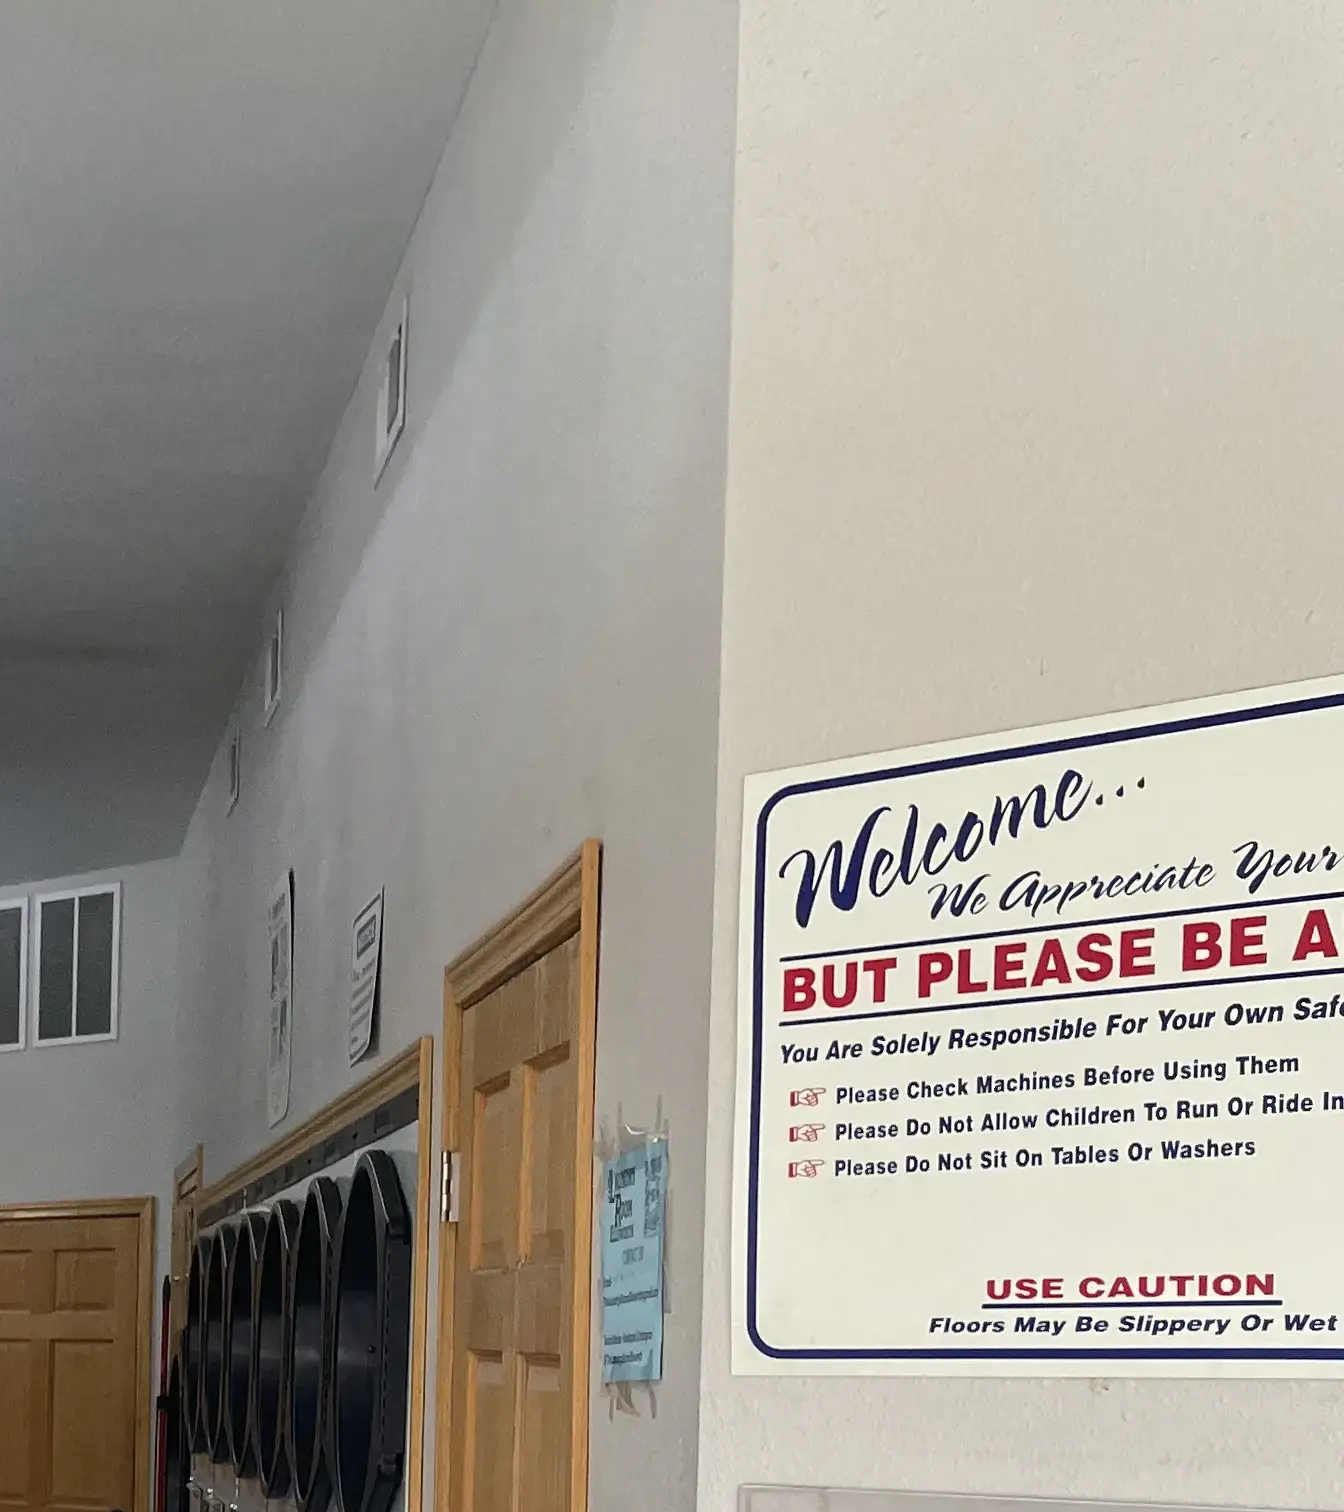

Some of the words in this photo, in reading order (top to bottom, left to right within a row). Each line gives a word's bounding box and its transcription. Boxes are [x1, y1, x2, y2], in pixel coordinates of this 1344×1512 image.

[778, 769, 1145, 929] Welcome...
[927, 873, 991, 920] We
[999, 856, 1216, 918] Appreciate
[1232, 841, 1344, 894] Your
[783, 957, 897, 1012] BUT
[917, 928, 1155, 998] PLEASE
[1182, 915, 1267, 972] BE
[1292, 909, 1339, 962] A
[781, 1044, 819, 1064] You
[825, 1040, 863, 1060] Are
[870, 1031, 941, 1056] Solely
[948, 1017, 1097, 1050] Responsible
[1106, 1014, 1148, 1036] For
[1158, 1009, 1216, 1031] Your
[1224, 1003, 1284, 1026] Own
[836, 1086, 899, 1104] Please
[907, 1078, 968, 1099] Check
[976, 1071, 1075, 1094] Machines
[1084, 1065, 1155, 1087] Before
[1164, 1059, 1227, 1081] Using
[1236, 1055, 1299, 1076] Them
[835, 1123, 899, 1141] Please
[906, 1118, 931, 1136] Do
[939, 1115, 973, 1134] Not
[981, 1112, 1038, 1132] Allow
[1046, 1106, 1135, 1127] Children
[1144, 1102, 1167, 1121] To
[1177, 1100, 1218, 1119] Run
[1228, 1096, 1253, 1116] Or
[1262, 1094, 1313, 1114] Ride
[1324, 1091, 1344, 1110] In
[835, 1158, 897, 1177] Please
[905, 1155, 930, 1173] Do
[938, 1153, 972, 1171] Not
[980, 1150, 1007, 1169] Sit
[1015, 1149, 1043, 1167] On
[1051, 1146, 1119, 1166] Tables
[1128, 1143, 1152, 1161] Or
[1161, 1138, 1256, 1160] Washers
[986, 1278, 1064, 1300] USE
[1078, 1273, 1275, 1298] CAUTION
[929, 1317, 1005, 1334] Floors
[1014, 1316, 1066, 1336] May
[1075, 1316, 1109, 1332] Be
[1118, 1314, 1231, 1335] Slippery
[1240, 1314, 1274, 1331] Or
[1284, 1313, 1338, 1332] Wet
